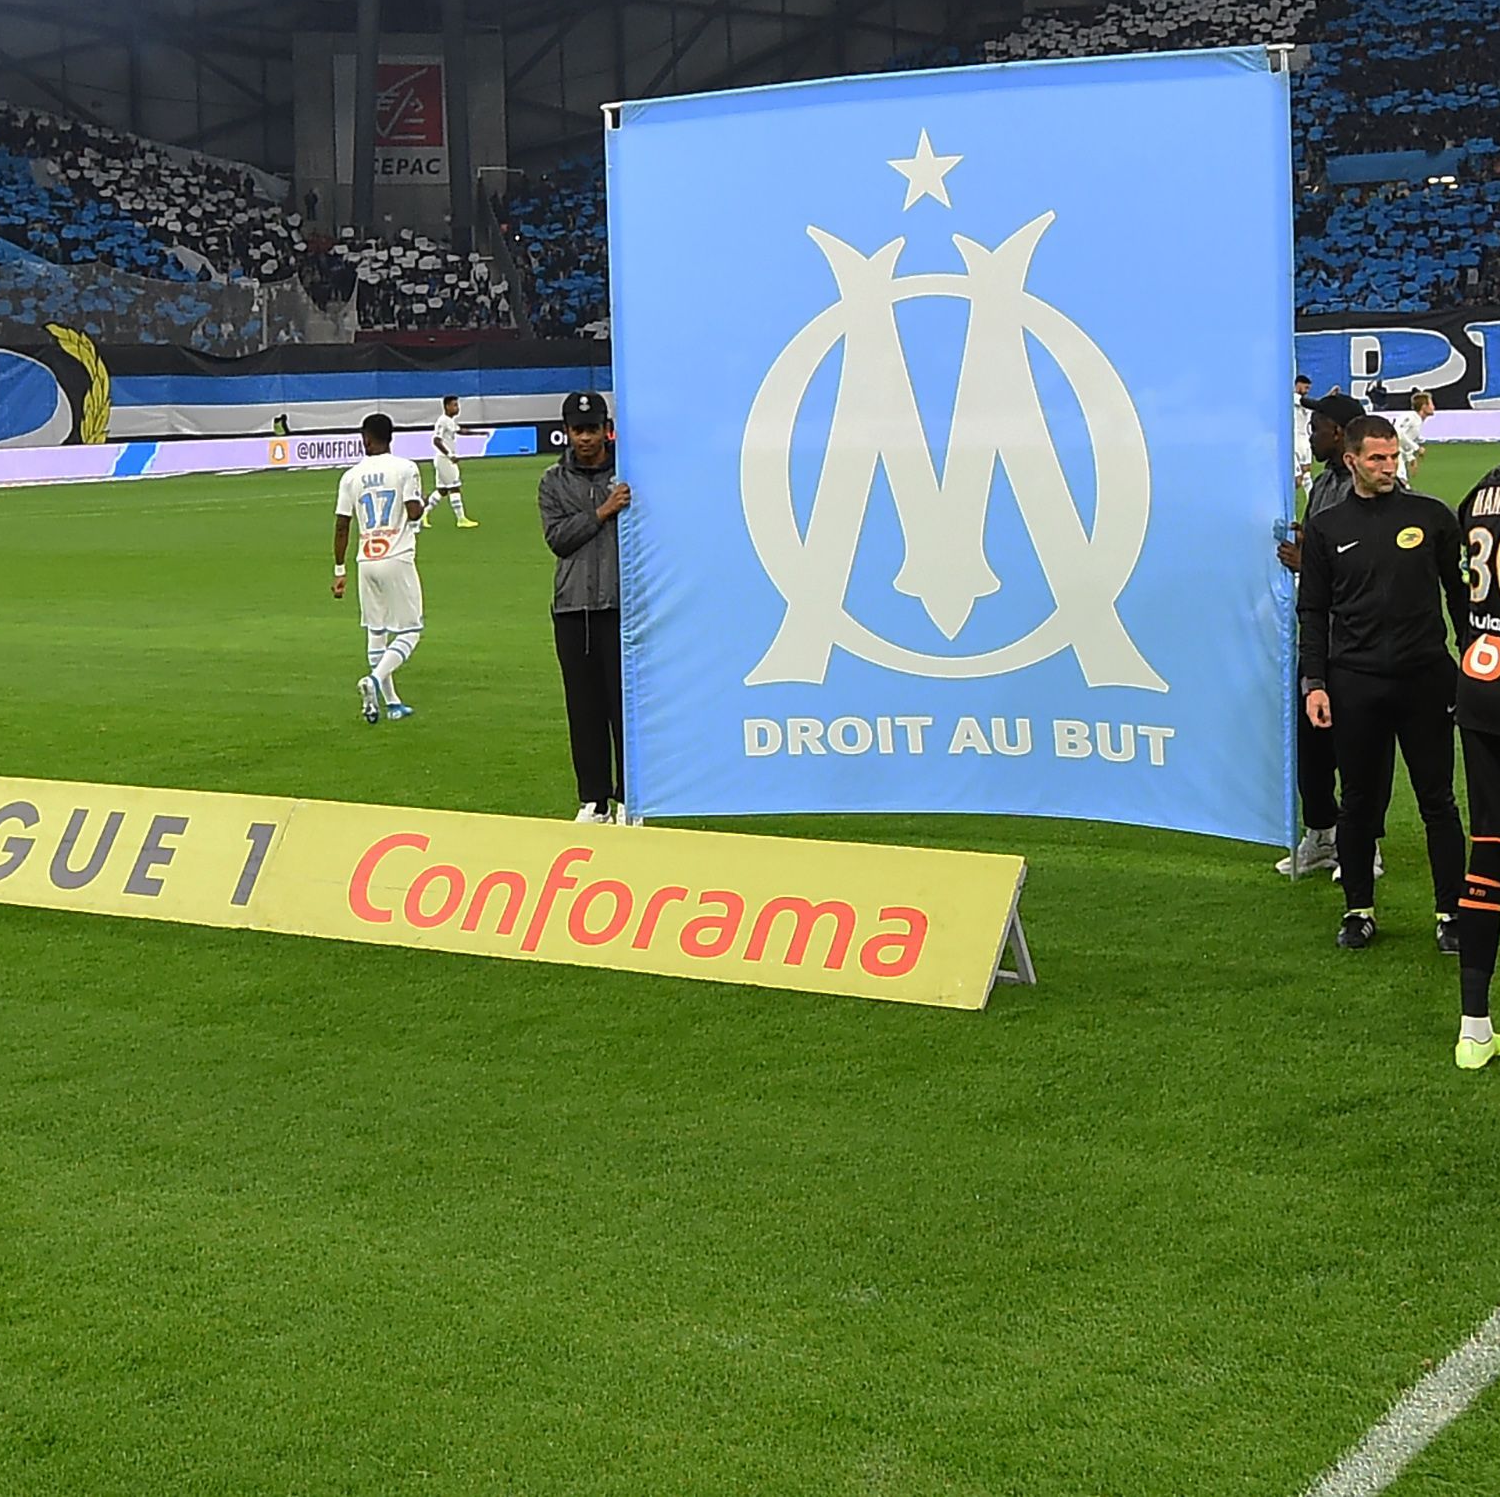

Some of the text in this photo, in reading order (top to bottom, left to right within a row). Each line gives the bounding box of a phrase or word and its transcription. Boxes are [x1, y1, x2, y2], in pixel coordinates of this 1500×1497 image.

[297, 439, 365, 460] @OMOFFICIA
[361, 472, 385, 489] SARR
[358, 489, 397, 530] 17
[743, 716, 1176, 766] DROIT AU BUT
[229, 822, 278, 907] 1
[348, 831, 928, 978] Conforama
